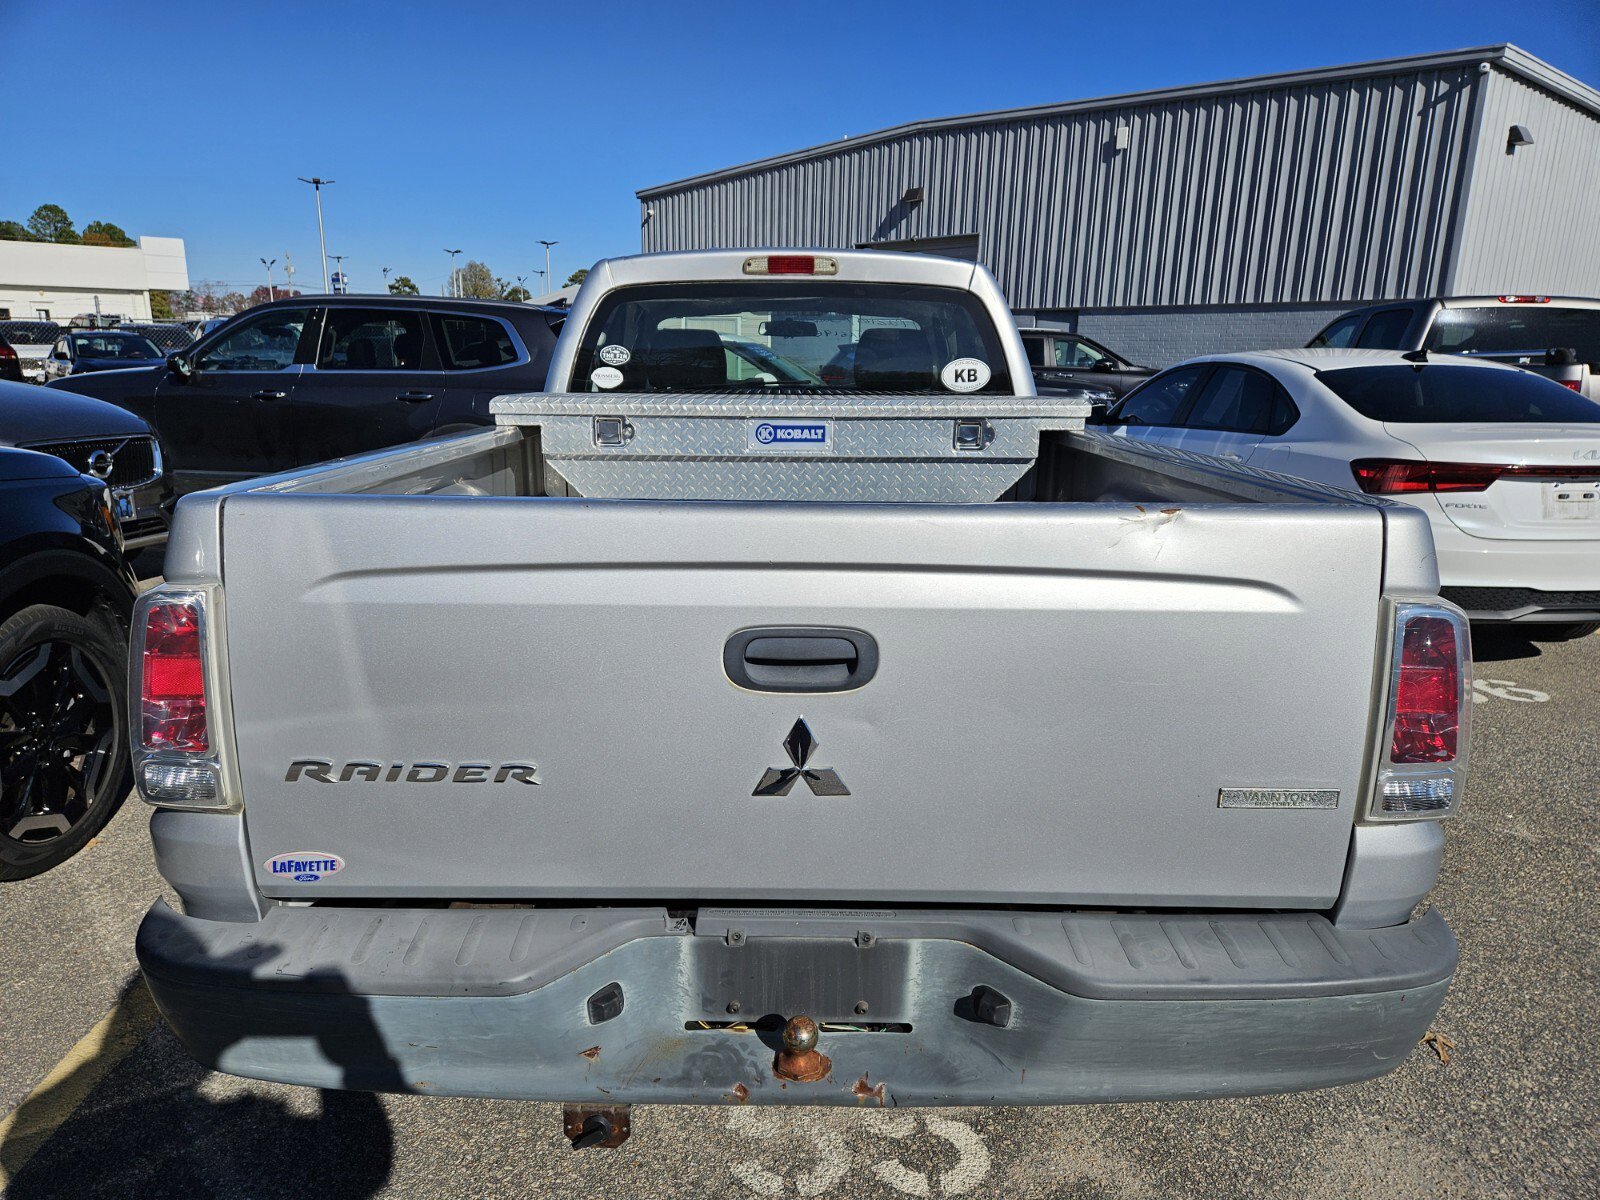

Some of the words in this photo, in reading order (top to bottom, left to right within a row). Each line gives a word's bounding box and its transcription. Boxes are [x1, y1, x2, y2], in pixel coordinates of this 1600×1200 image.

[954, 368, 978, 383] KB
[776, 428, 824, 440] KOBALT
[1444, 501, 1489, 510] FORTE
[53, 622, 85, 636] PIRELLI
[284, 757, 542, 786] RAIDER
[298, 874, 316, 882] Ford
